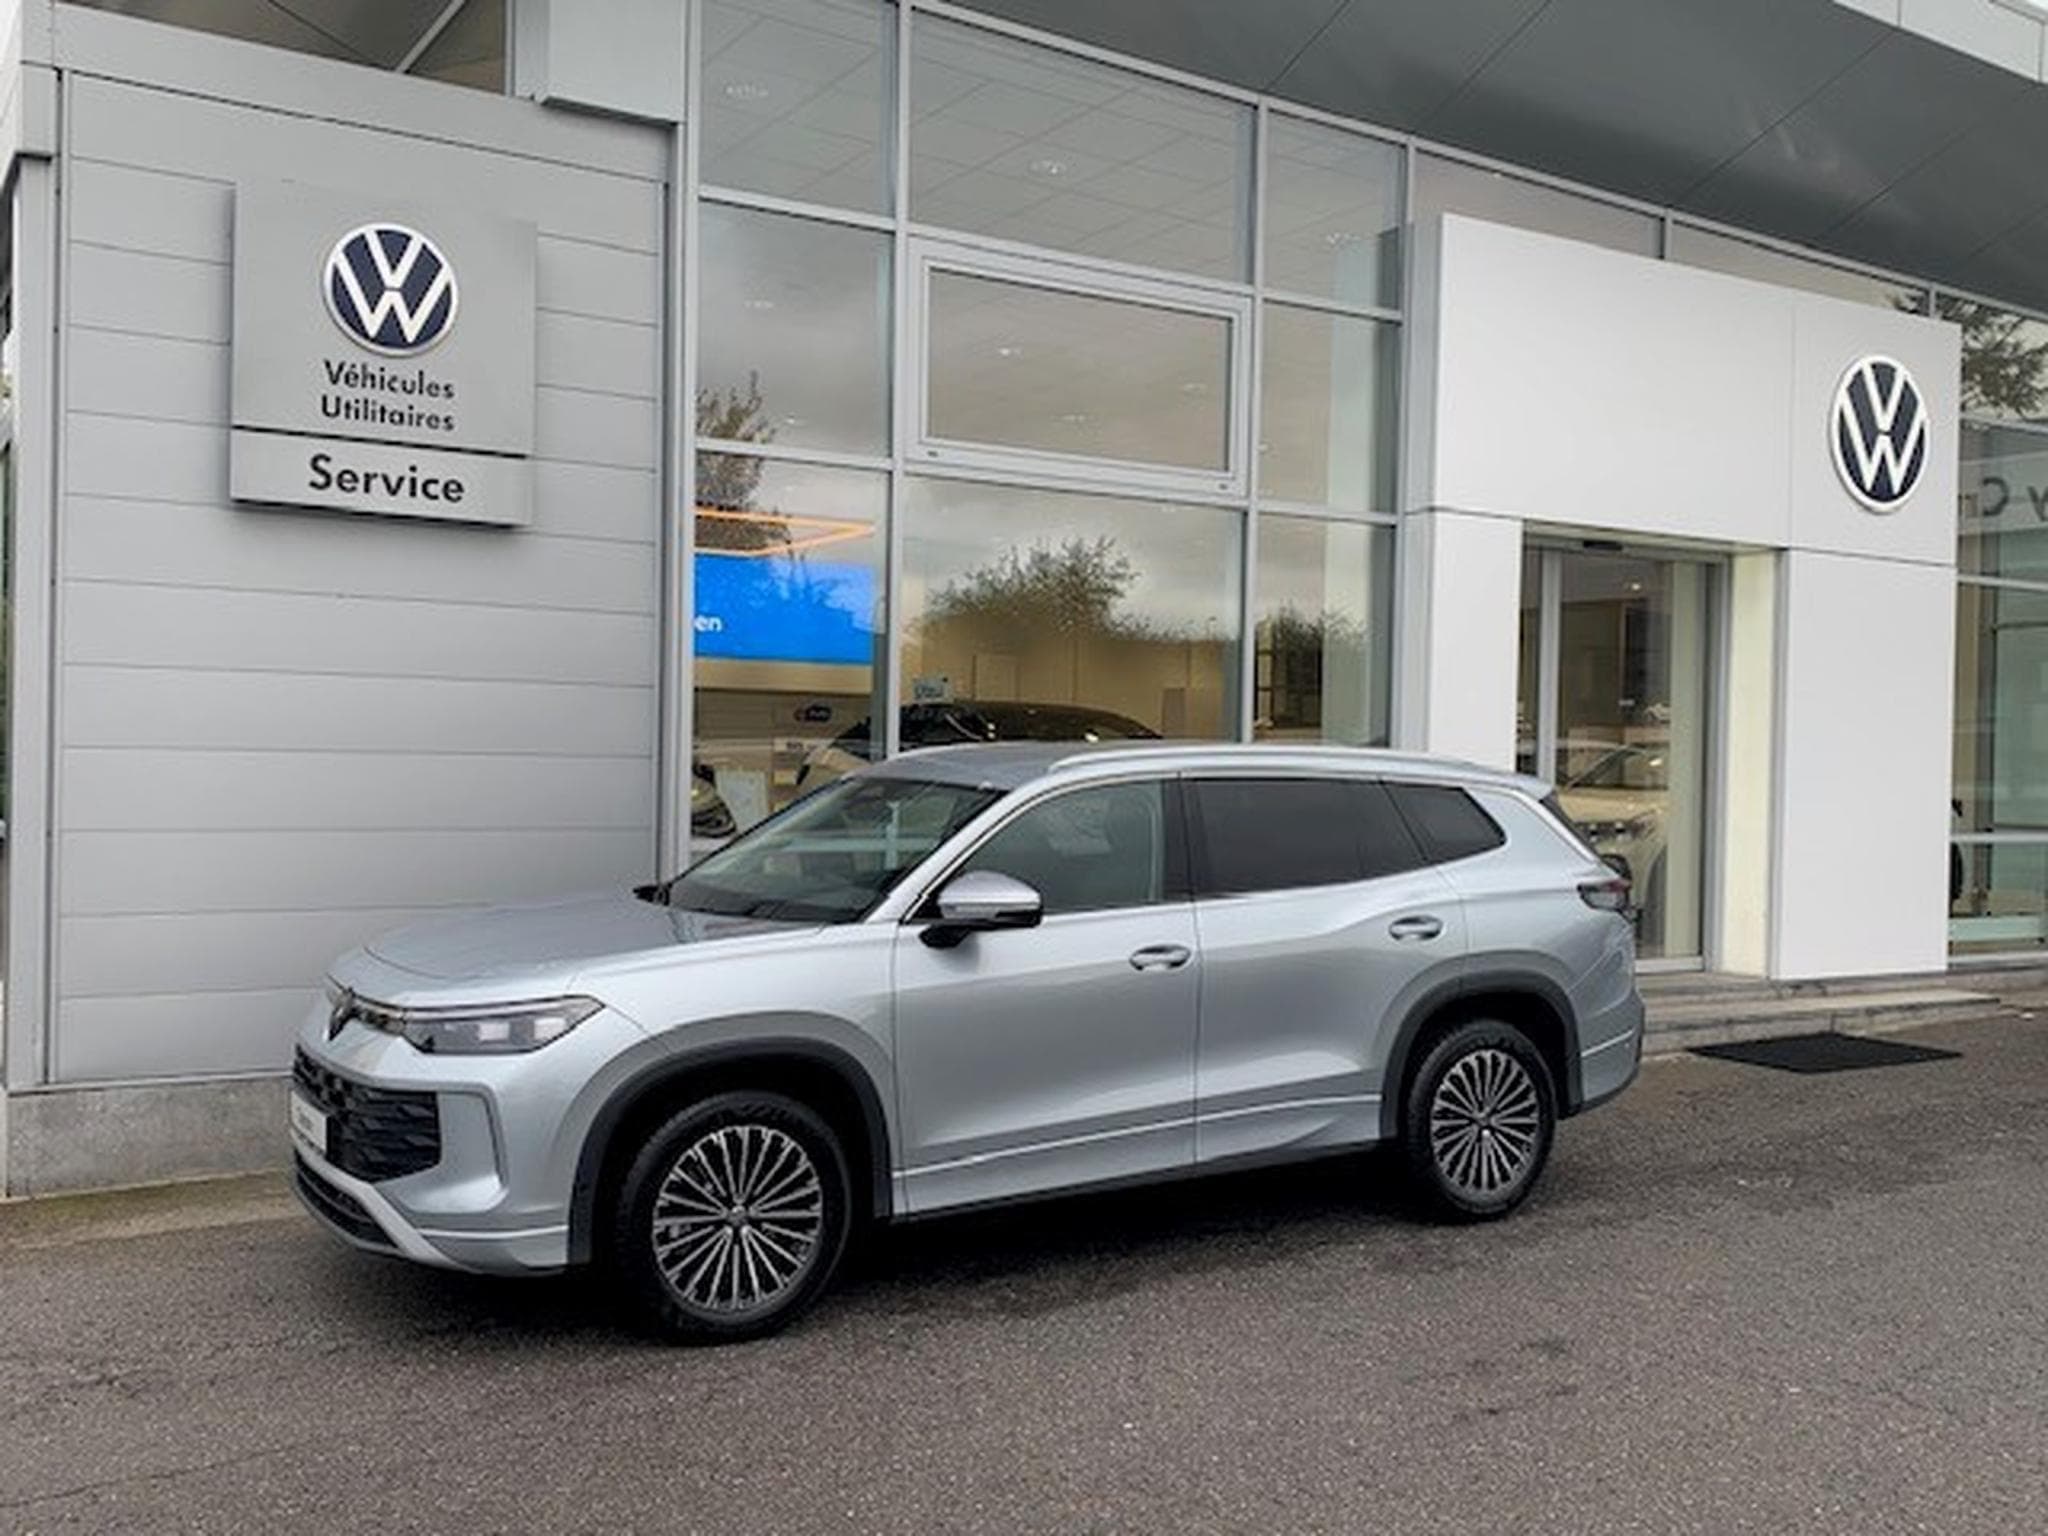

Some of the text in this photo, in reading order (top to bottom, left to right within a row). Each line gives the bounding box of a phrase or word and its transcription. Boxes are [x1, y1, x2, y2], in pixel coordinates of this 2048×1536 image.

[327, 223, 455, 347] VW
[324, 360, 455, 398] Véhicules
[322, 395, 455, 431] Utilitaires
[1833, 357, 1929, 504] VW
[309, 454, 465, 502] Service
